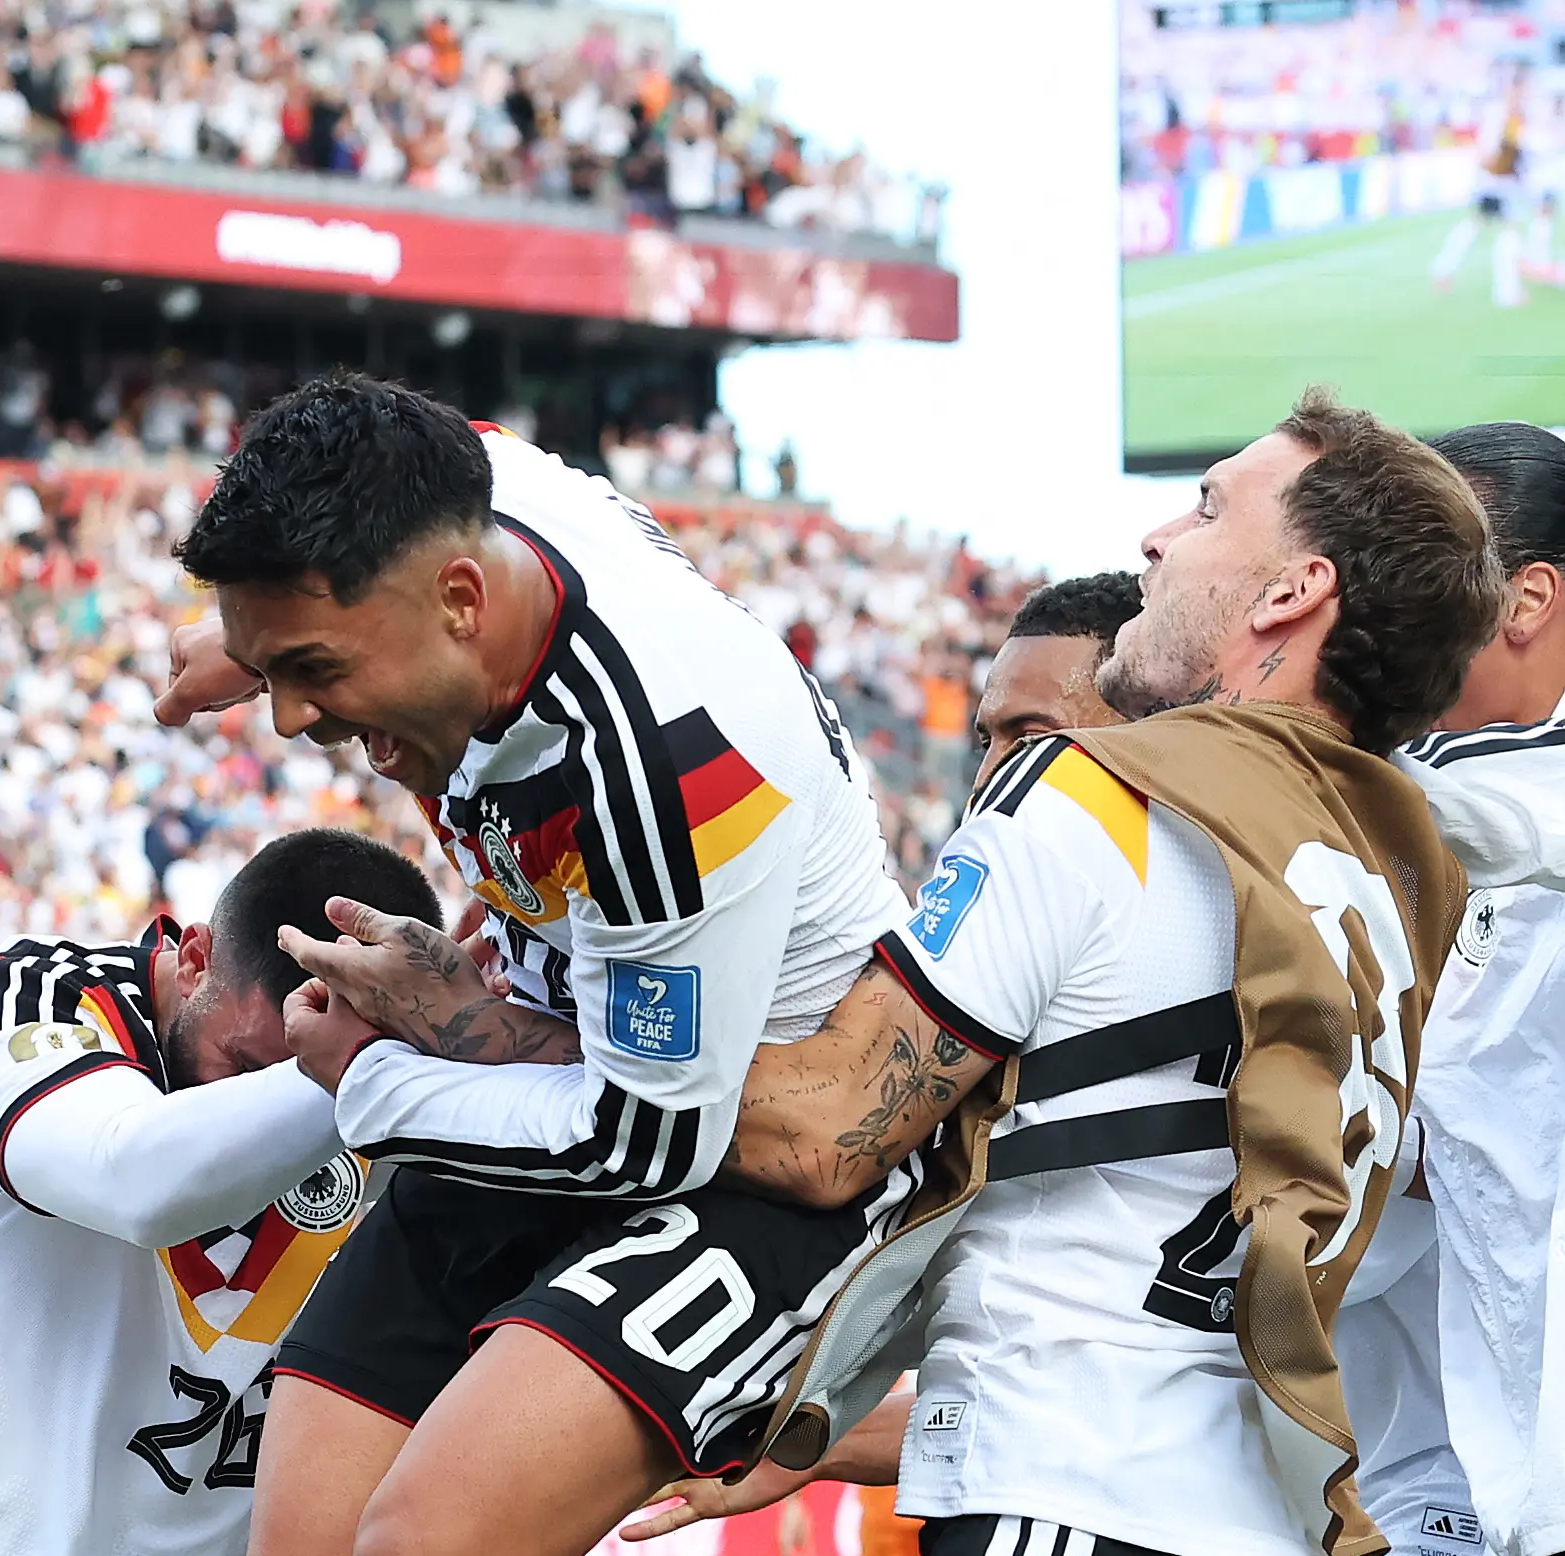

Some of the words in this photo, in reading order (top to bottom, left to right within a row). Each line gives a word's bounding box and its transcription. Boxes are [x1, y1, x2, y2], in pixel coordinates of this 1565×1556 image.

[626, 999, 657, 1020] Unite
[657, 1006, 676, 1023] For
[629, 1017, 673, 1041] PEACE
[637, 1038, 662, 1050] FIFA
[293, 1184, 350, 1218] FUSSBALL-BUND
[548, 1203, 756, 1372] 20
[126, 1357, 276, 1496] 26
